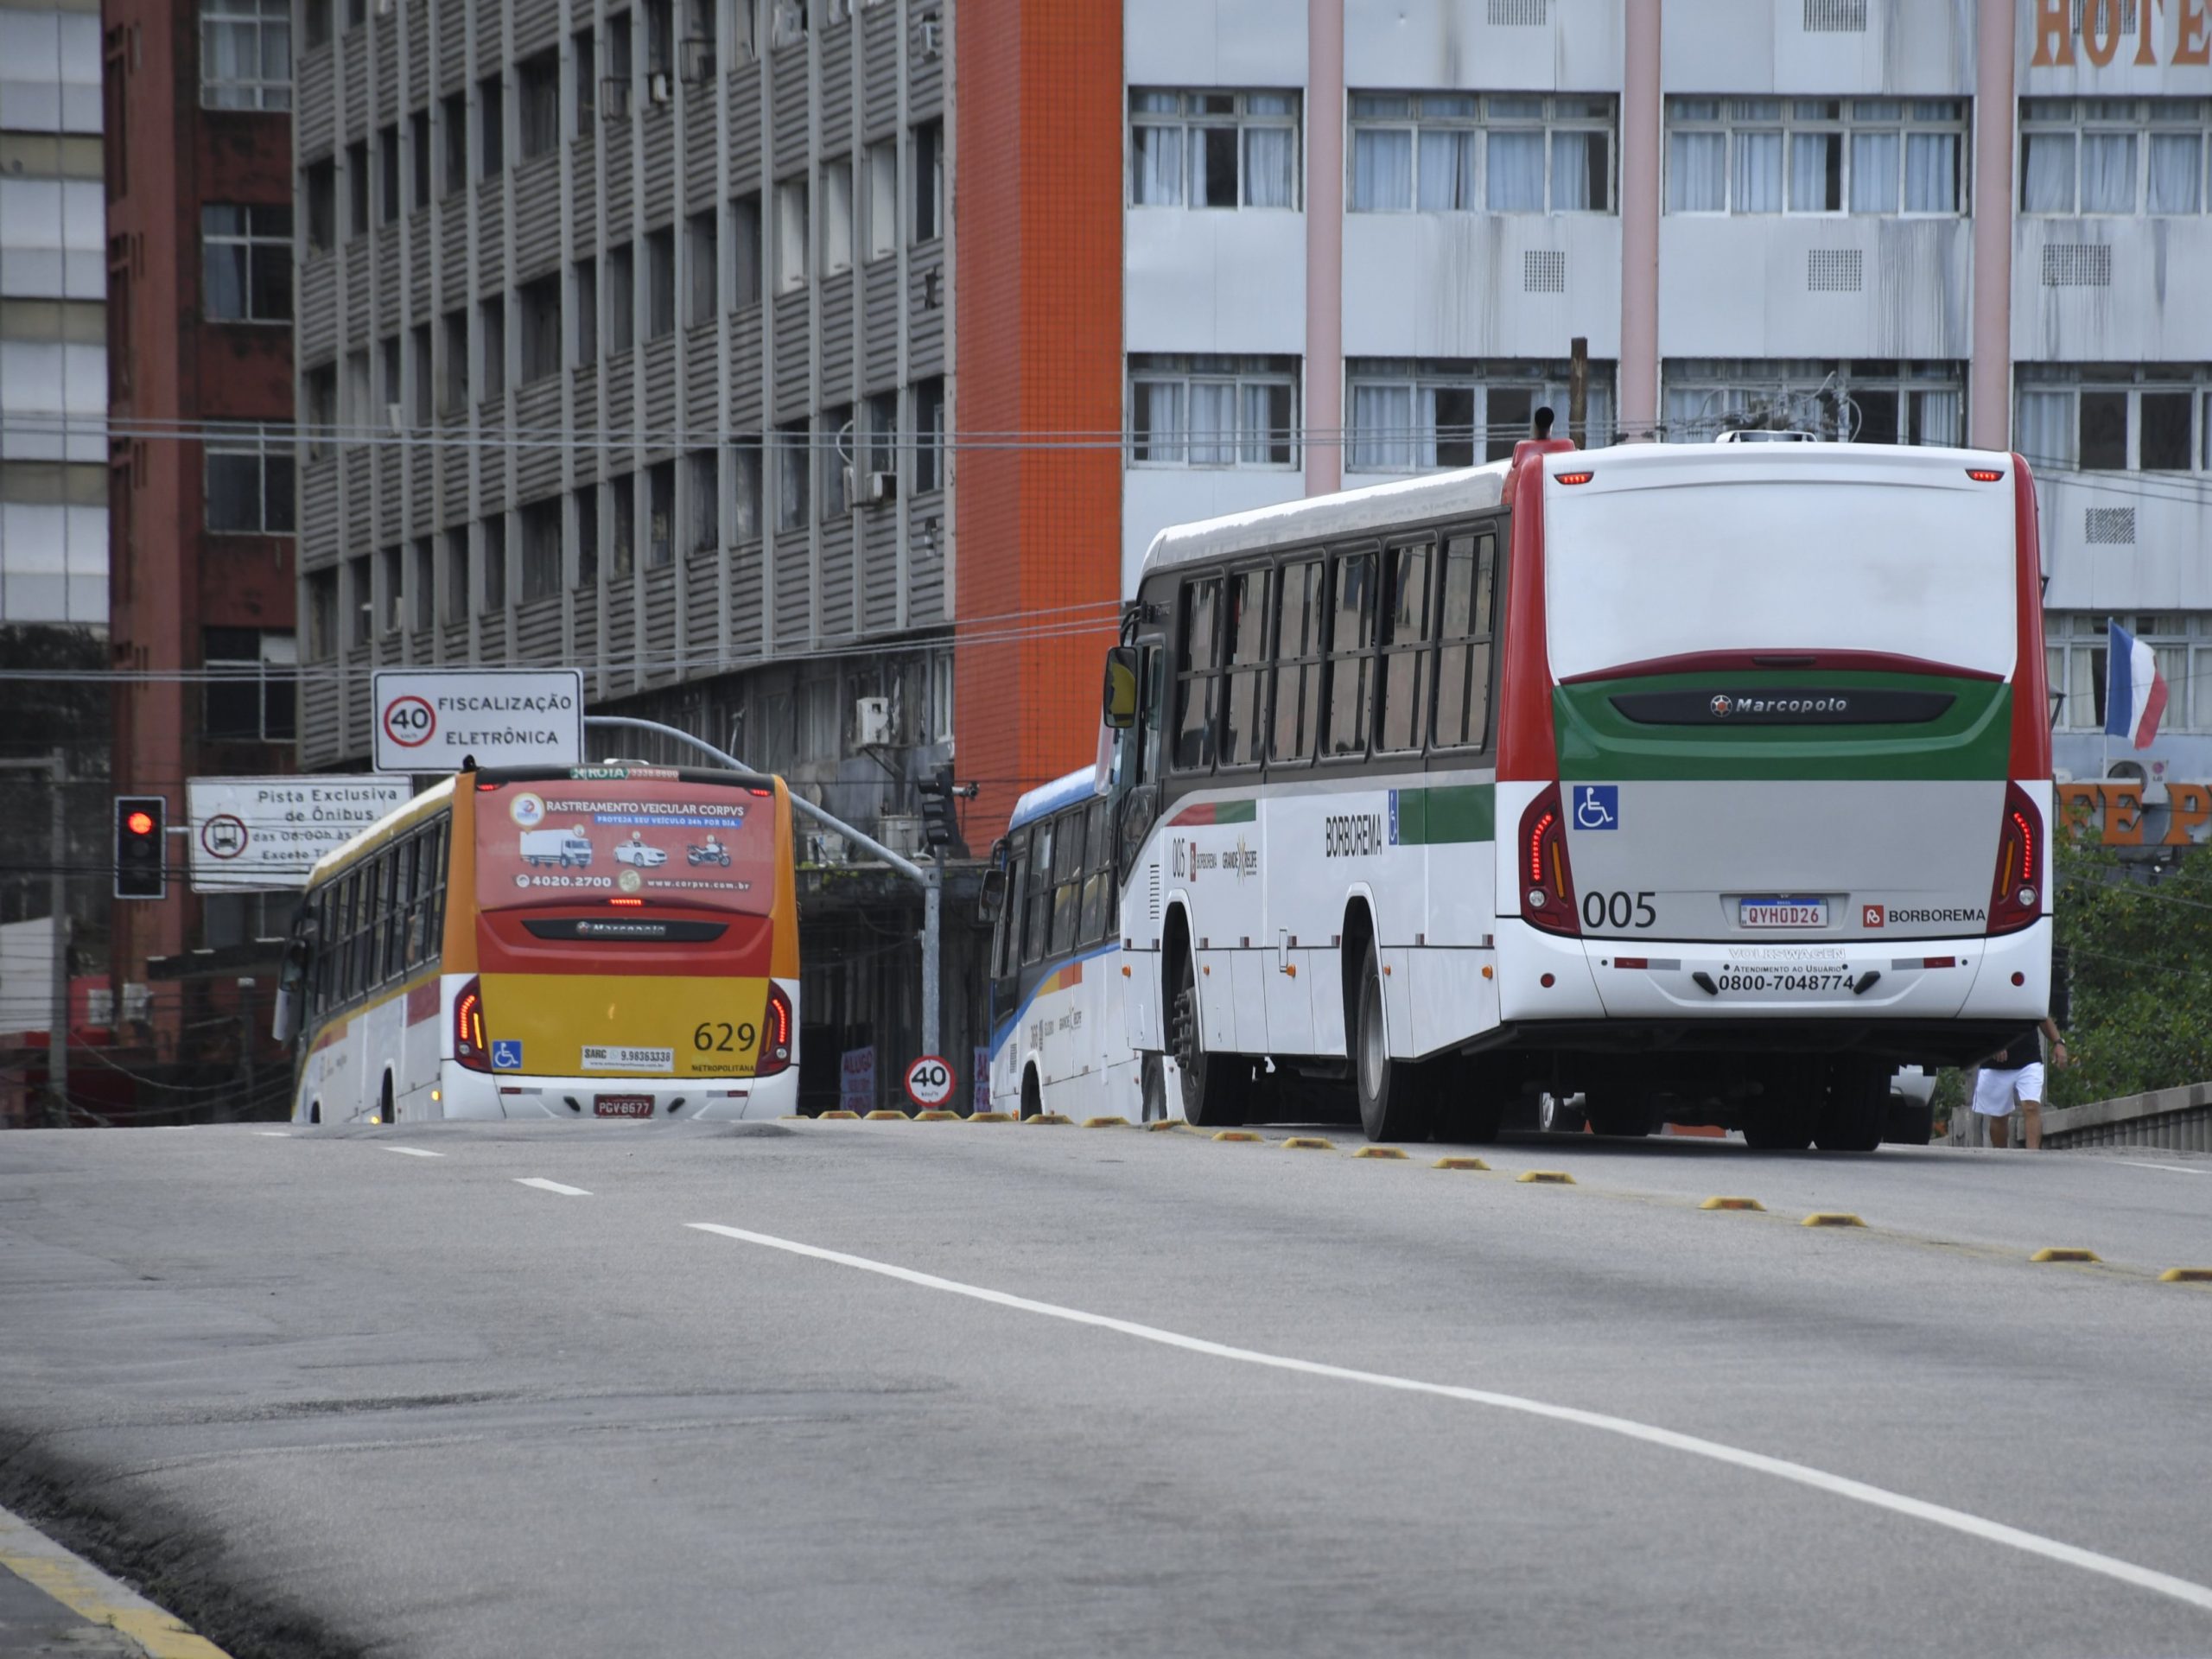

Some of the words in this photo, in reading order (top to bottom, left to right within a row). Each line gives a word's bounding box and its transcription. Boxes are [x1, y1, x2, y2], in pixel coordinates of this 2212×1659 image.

[437, 693, 572, 713] FISCALIZAÇÃO
[1736, 696, 1847, 714] Marcopolo
[391, 708, 429, 729] 40
[446, 727, 558, 746] ELETRÔNICA
[258, 790, 304, 803] Pista
[312, 787, 397, 801] Exclusiva
[285, 810, 305, 822] de
[546, 801, 639, 812] RASTREAMENTO
[641, 803, 696, 815] VEICULAR
[699, 804, 744, 817] CORPVS
[1325, 814, 1382, 857] BORBOREMA
[531, 876, 612, 887] 4020.2700
[648, 880, 749, 890] www.corpvs.com.br
[1582, 891, 1657, 929] 005
[1889, 909, 1986, 922] BORBOREMA
[1728, 947, 1847, 960] VOLKSWAGEN
[1719, 975, 1854, 991] 0800-7048774
[694, 1022, 756, 1052] 629
[911, 1065, 947, 1087] 40
